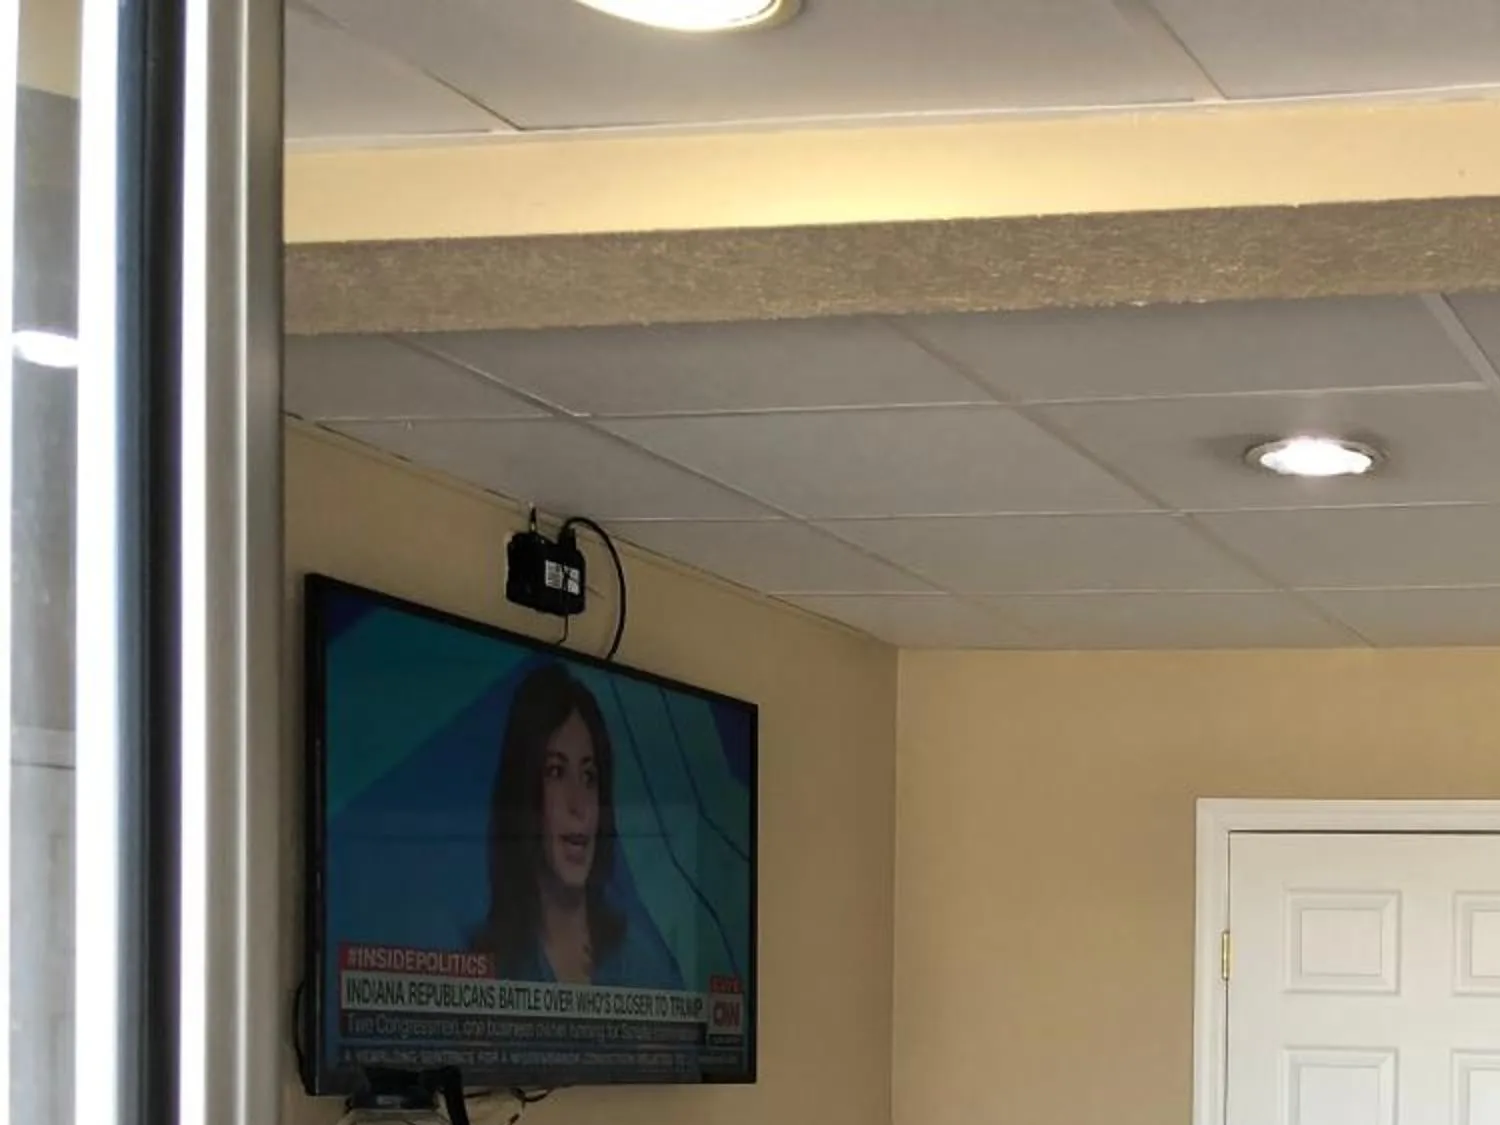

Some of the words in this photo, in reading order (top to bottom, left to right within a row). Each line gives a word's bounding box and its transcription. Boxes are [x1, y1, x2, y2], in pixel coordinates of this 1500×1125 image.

[346, 947, 489, 975] #INSIDEPOLITICS
[346, 978, 404, 1005] INDIANA
[409, 981, 496, 1009] REPUBLICANS
[499, 986, 540, 1011] BATTLE
[544, 989, 573, 1012] OVER
[576, 991, 611, 1015] WHO'S
[613, 993, 653, 1016] CLOSER
[655, 995, 669, 1017] TO
